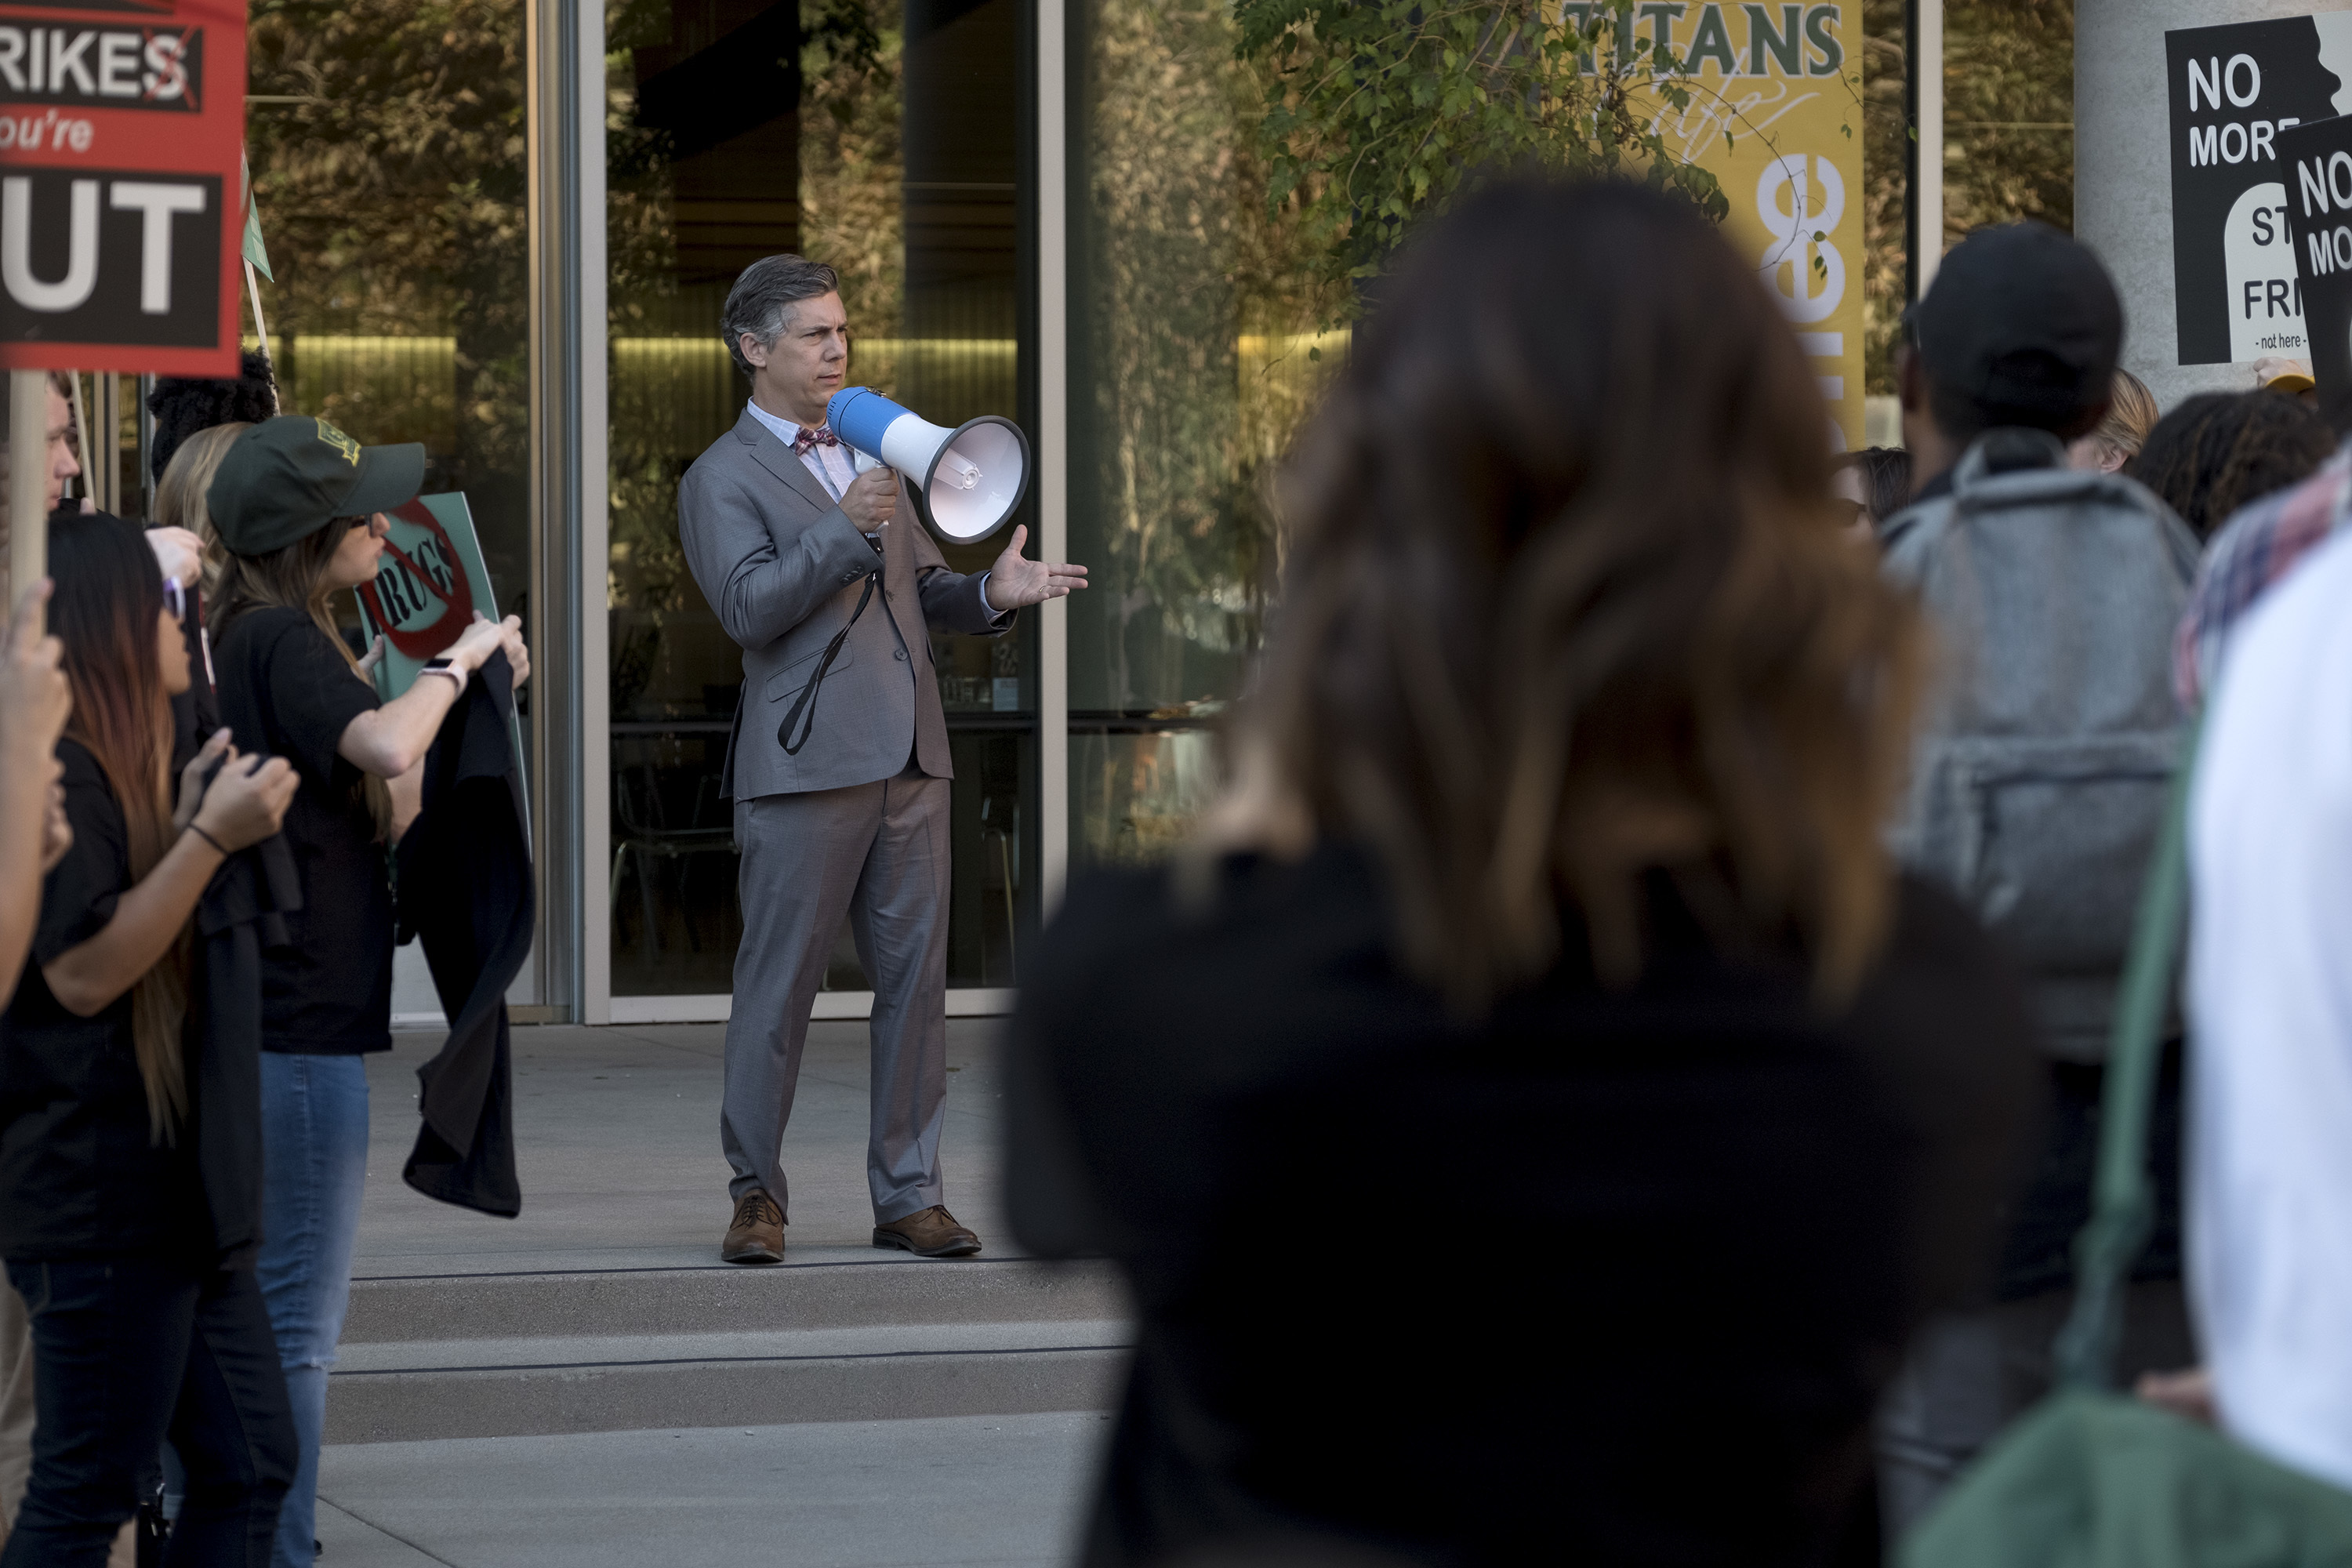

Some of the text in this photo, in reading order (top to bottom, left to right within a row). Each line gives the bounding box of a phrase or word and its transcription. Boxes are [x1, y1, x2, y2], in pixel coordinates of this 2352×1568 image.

[1563, 2, 1844, 78] TITANS
[2188, 53, 2261, 112] NO
[2298, 151, 2352, 218] NO
[2, 176, 206, 314] UT
[2261, 333, 2278, 350] not
[2278, 332, 2301, 349] here
